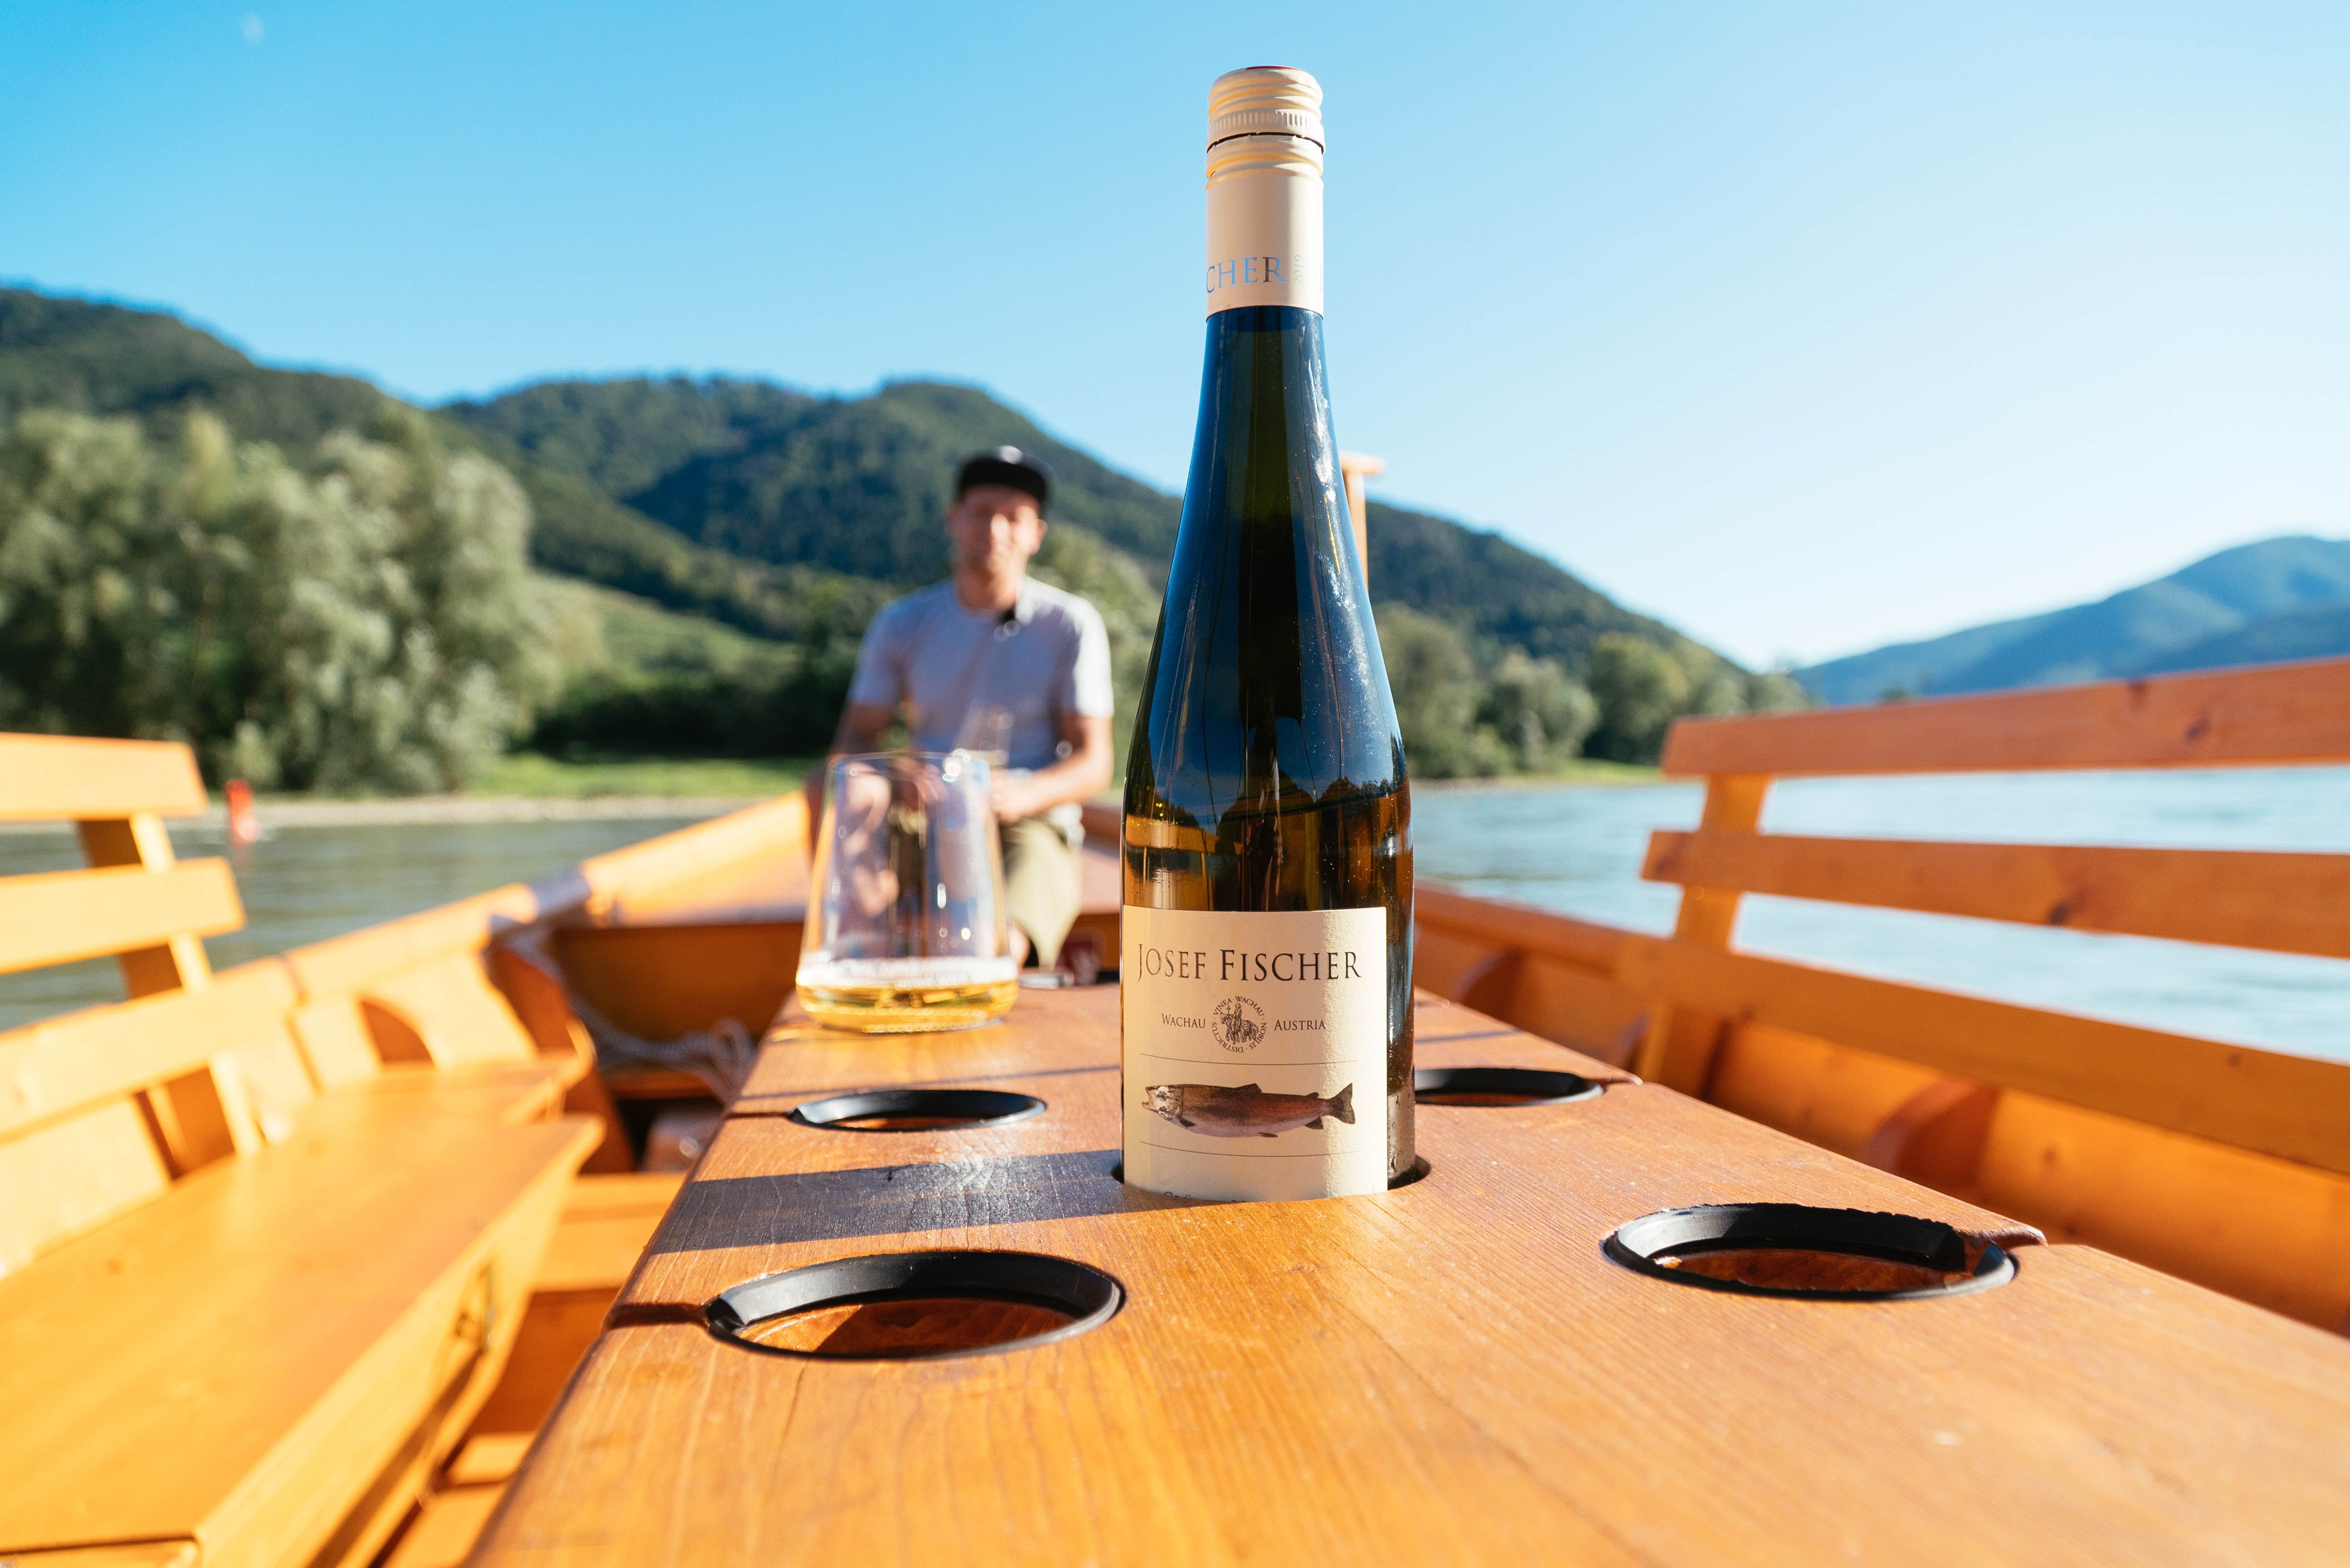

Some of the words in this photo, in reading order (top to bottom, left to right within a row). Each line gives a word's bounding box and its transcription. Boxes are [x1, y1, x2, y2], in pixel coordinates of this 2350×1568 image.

[1294, 255, 1303, 285] 2019
[1138, 944, 1206, 982] JOSEF
[1220, 949, 1362, 981] FISCHER
[1213, 998, 1232, 1015] VINEA
[1235, 996, 1265, 1016] WACHAU
[1161, 1014, 1206, 1029] WACHAU
[1274, 1019, 1326, 1030] AUSTRIA
[1249, 1022, 1266, 1050] NOBILIS
[1211, 1022, 1244, 1053] DISTRICTUS
